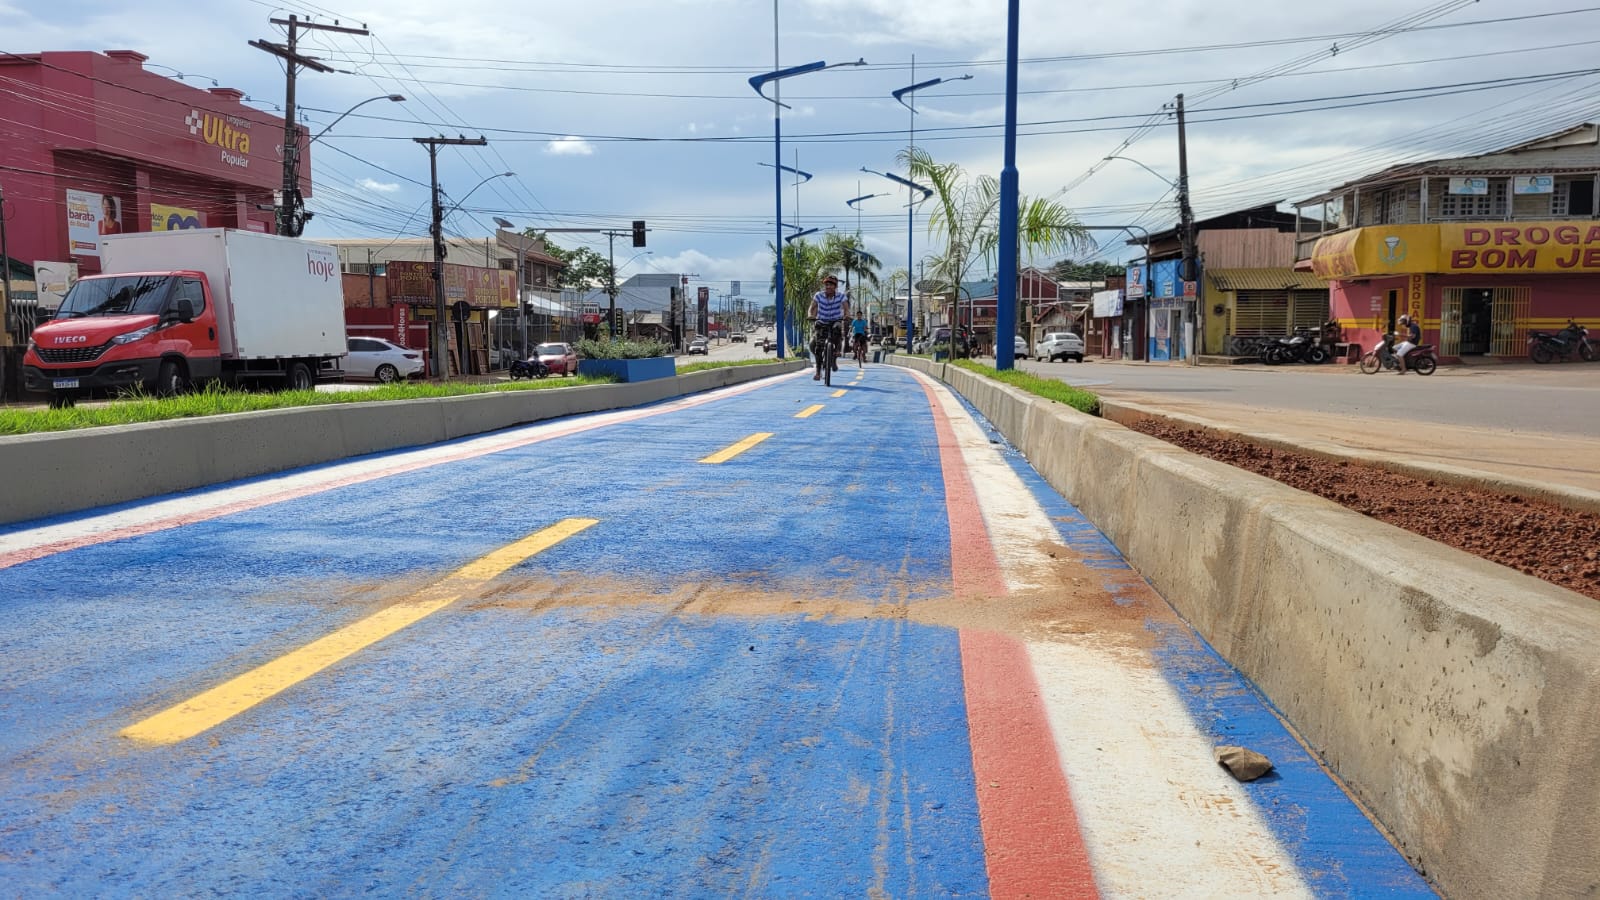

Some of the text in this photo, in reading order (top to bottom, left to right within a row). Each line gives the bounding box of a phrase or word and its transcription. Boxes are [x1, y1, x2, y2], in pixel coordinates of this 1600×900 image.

[203, 113, 251, 154] Ultra
[221, 150, 248, 168] Popular
[69, 208, 95, 222] barata
[1464, 226, 1600, 246] DROGA
[307, 252, 335, 282] hoje
[1451, 249, 1537, 269] BOM
[398, 308, 406, 346] co24Horas
[54, 335, 87, 344] IVECO
